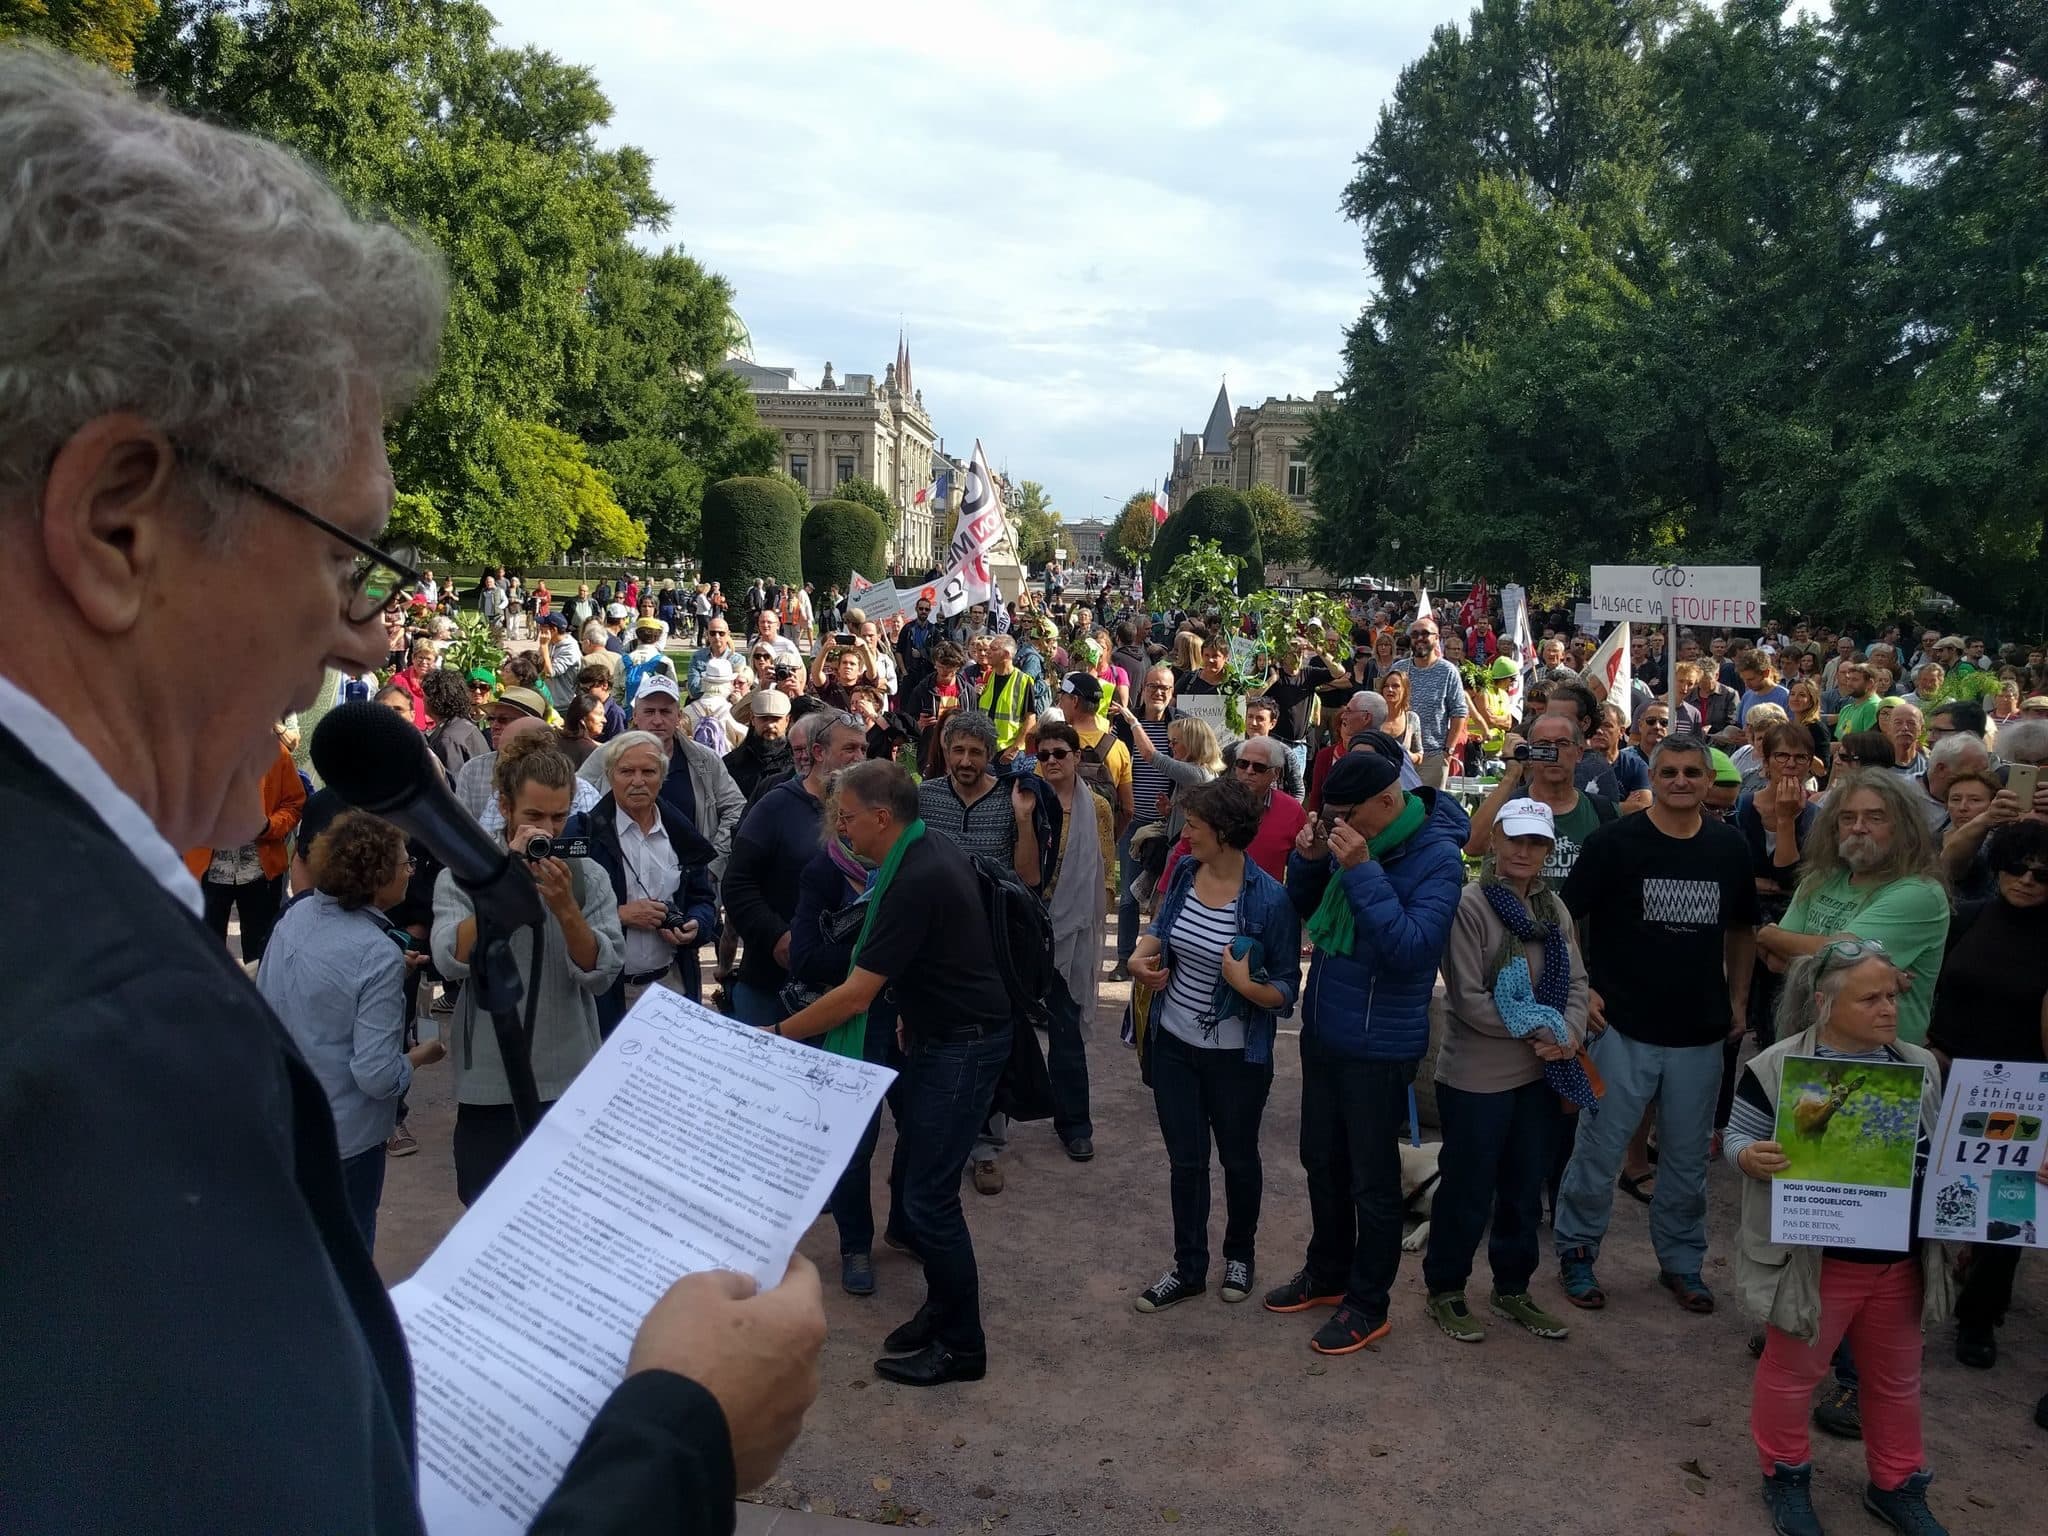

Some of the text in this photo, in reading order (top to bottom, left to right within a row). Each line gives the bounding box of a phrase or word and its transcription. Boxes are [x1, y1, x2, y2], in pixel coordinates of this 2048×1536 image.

[1593, 594, 1757, 625] L'ALSACE VA ETOUFFER
[1970, 1085, 2046, 1102] éthique
[1980, 1100, 2044, 1111] animaux
[1956, 1140, 2030, 1167] L214
[1783, 1183, 1803, 1191] NOUS
[1806, 1185, 1841, 1194] VOULONS
[1859, 1189, 1888, 1198] FORETS
[1998, 1190, 2026, 1200] NOW
[1783, 1206, 1798, 1215] PAS
[1783, 1220, 1798, 1228] PAS
[1800, 1233, 1811, 1241] DE
[1811, 1234, 1856, 1244] PESTICIDES
